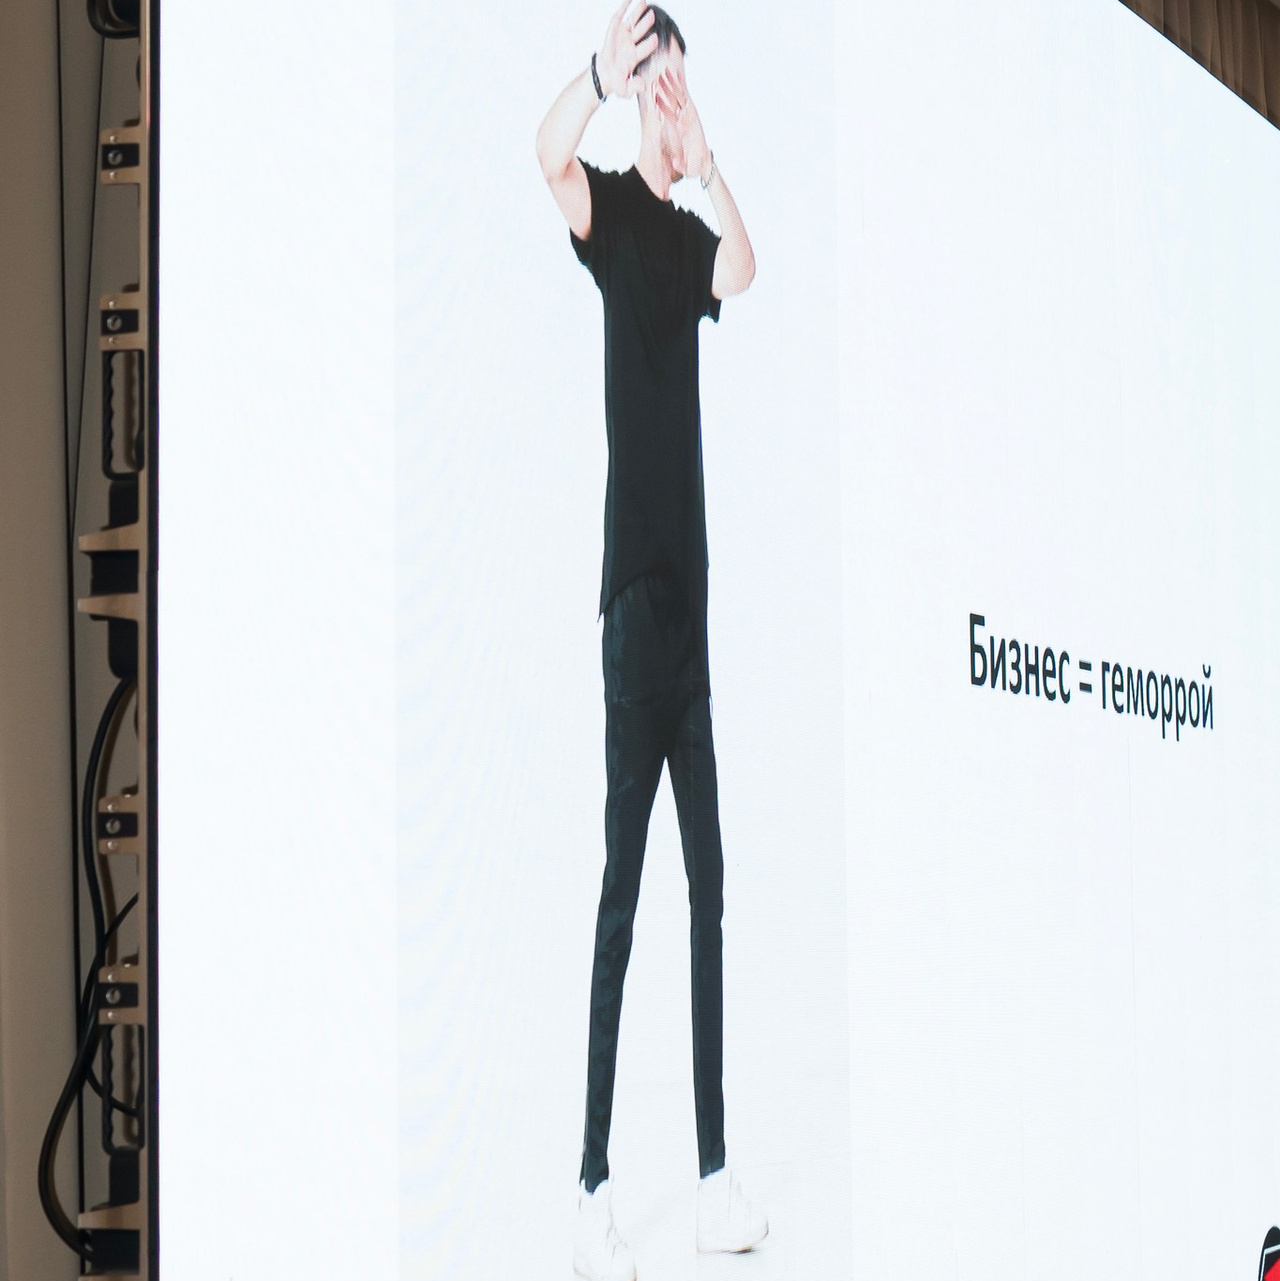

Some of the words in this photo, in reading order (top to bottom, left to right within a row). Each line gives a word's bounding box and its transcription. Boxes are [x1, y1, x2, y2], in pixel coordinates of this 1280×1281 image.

[969, 613, 1071, 704] Бизнес
[1079, 659, 1092, 693] =
[1101, 661, 1213, 742] геморрой
